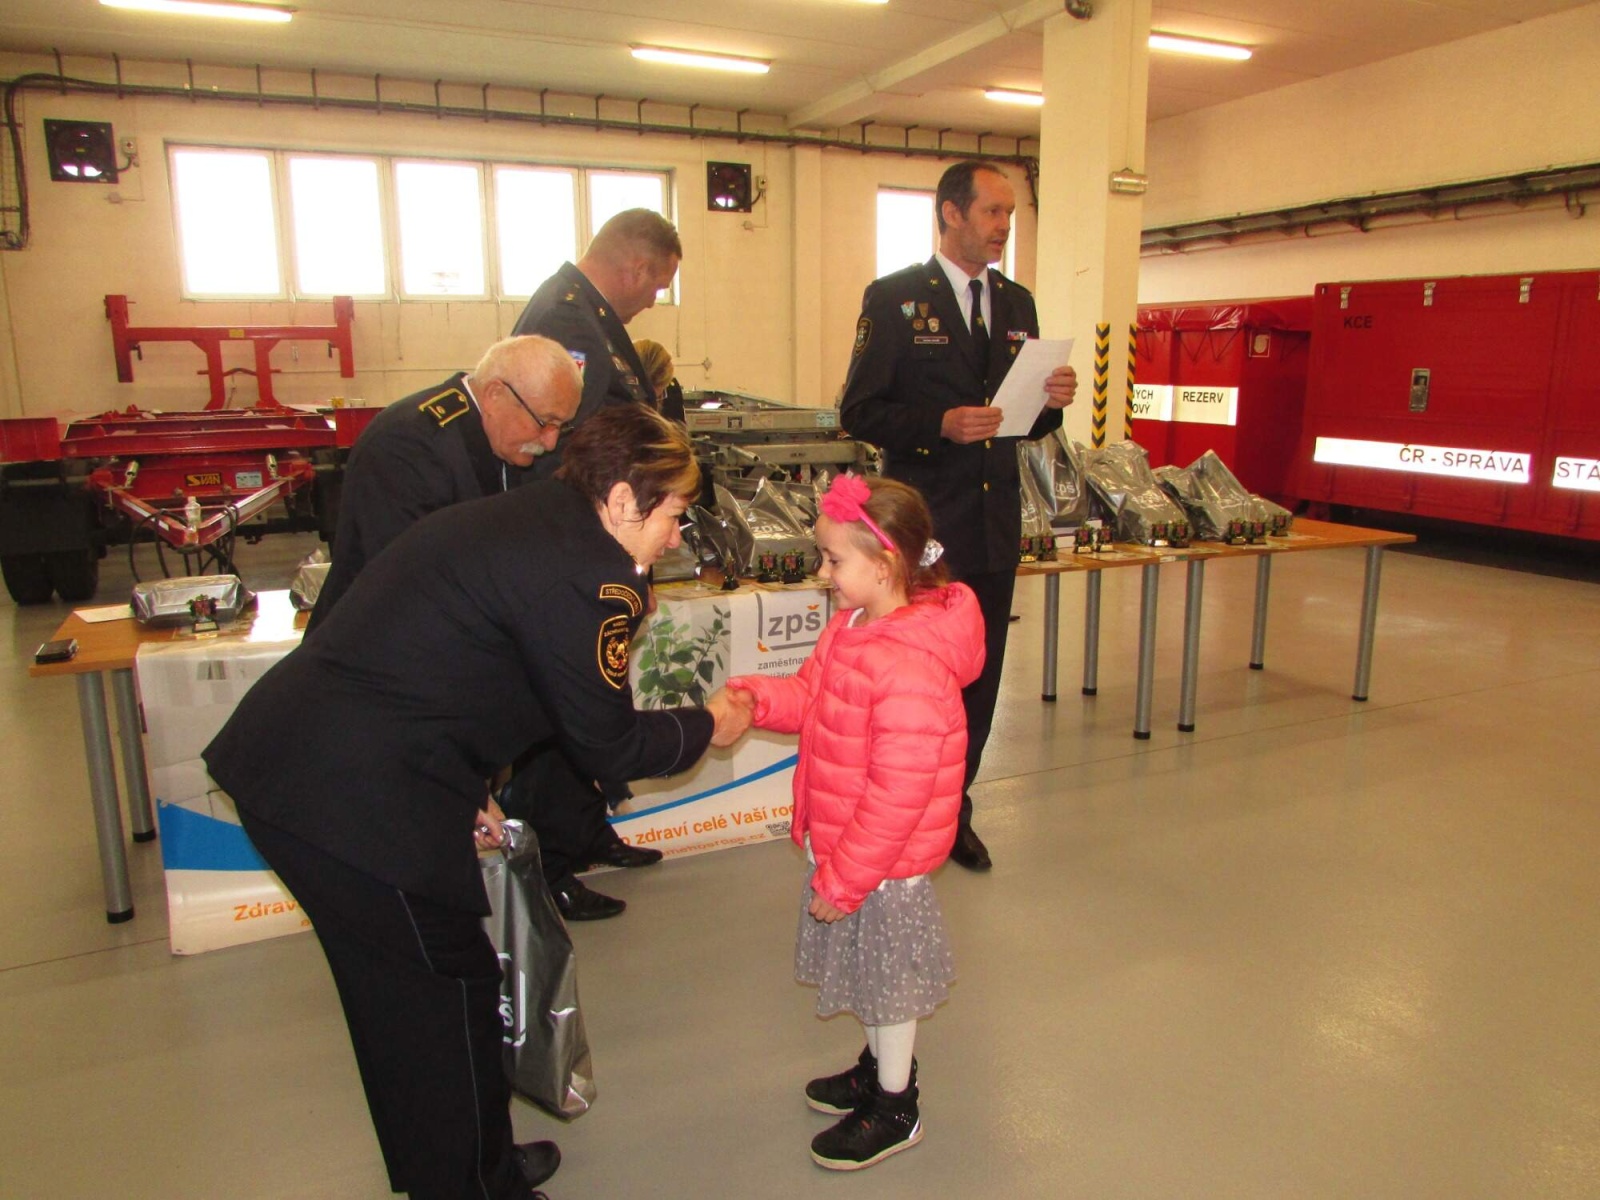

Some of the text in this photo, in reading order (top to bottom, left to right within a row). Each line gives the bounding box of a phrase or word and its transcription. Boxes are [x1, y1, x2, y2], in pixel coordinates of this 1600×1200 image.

[1343, 315, 1373, 329] KCE
[1182, 391, 1224, 404] REZERV
[1399, 442, 1425, 465] ČR
[1442, 450, 1525, 473] SPRÁVA
[768, 602, 822, 641] zpš
[635, 822, 688, 846] zdraví
[693, 815, 728, 834] celé
[731, 805, 768, 826] Vaší
